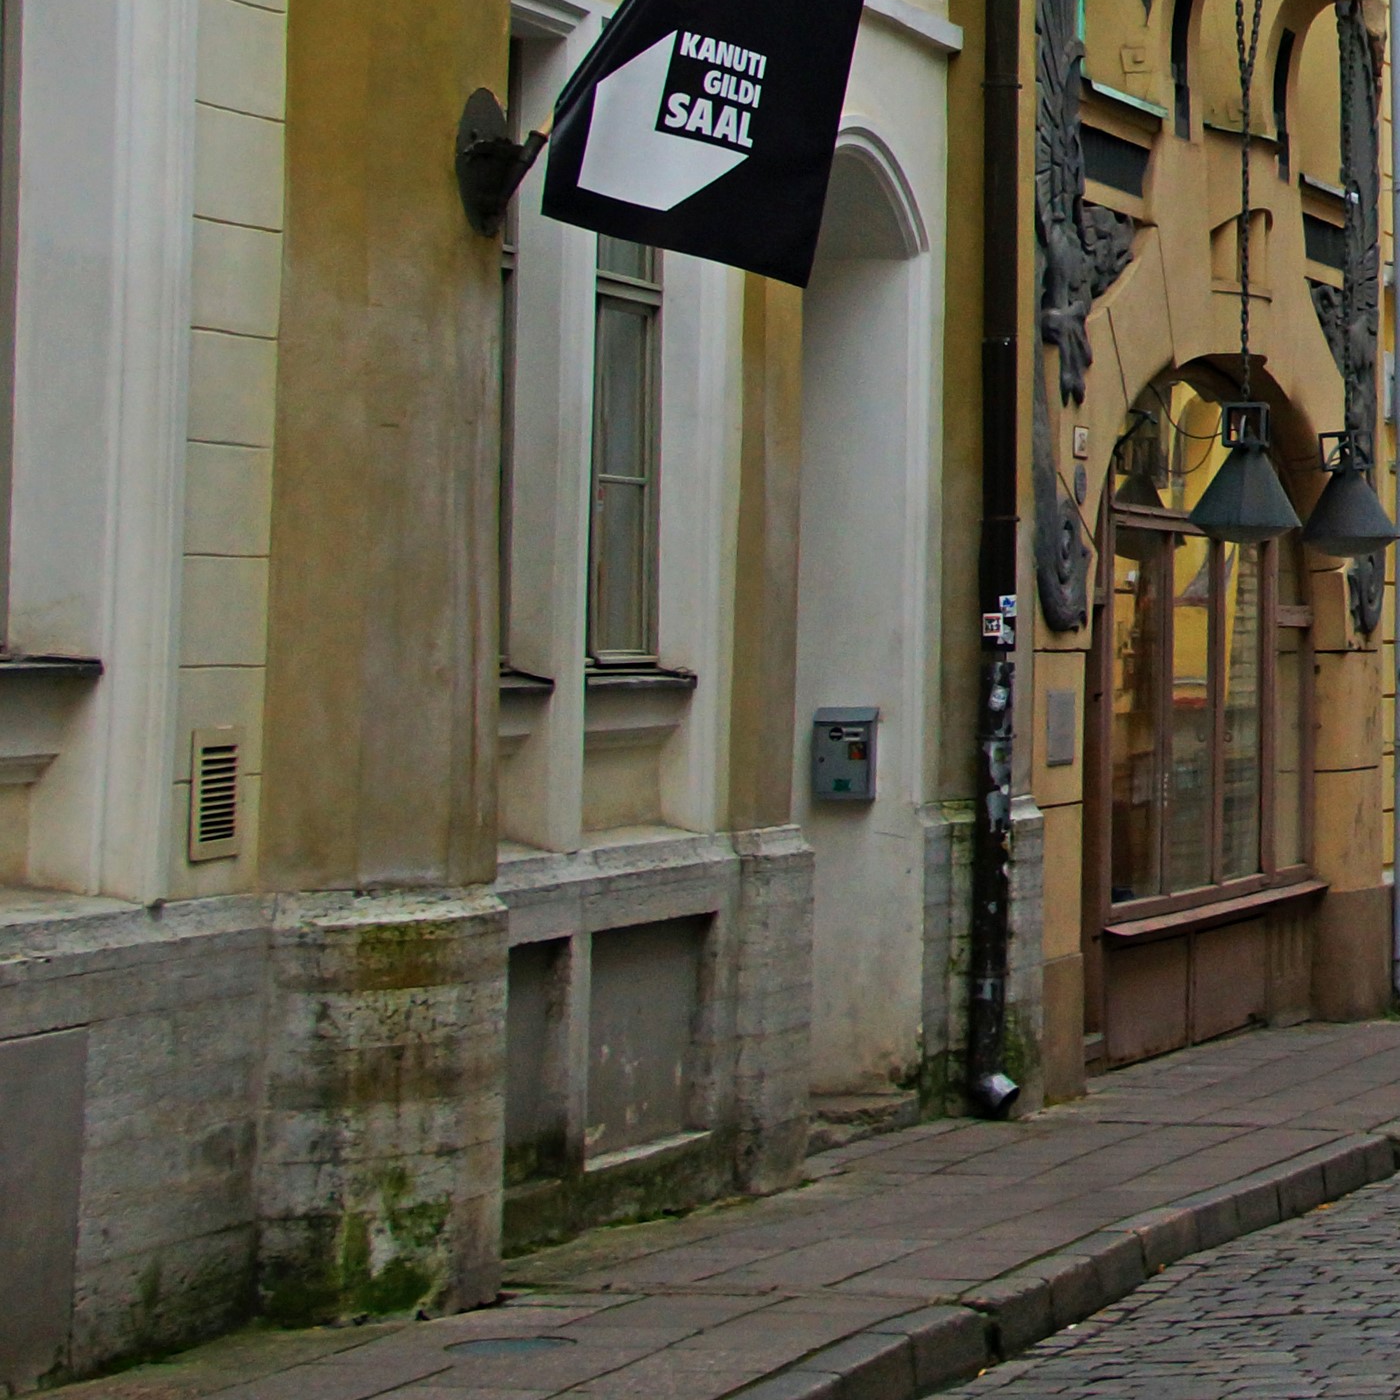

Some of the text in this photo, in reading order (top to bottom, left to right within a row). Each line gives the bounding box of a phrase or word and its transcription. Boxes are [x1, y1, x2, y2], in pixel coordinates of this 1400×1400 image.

[680, 31, 767, 79] KANUTI
[703, 70, 761, 108] GILDI
[664, 92, 753, 148] SAAL
